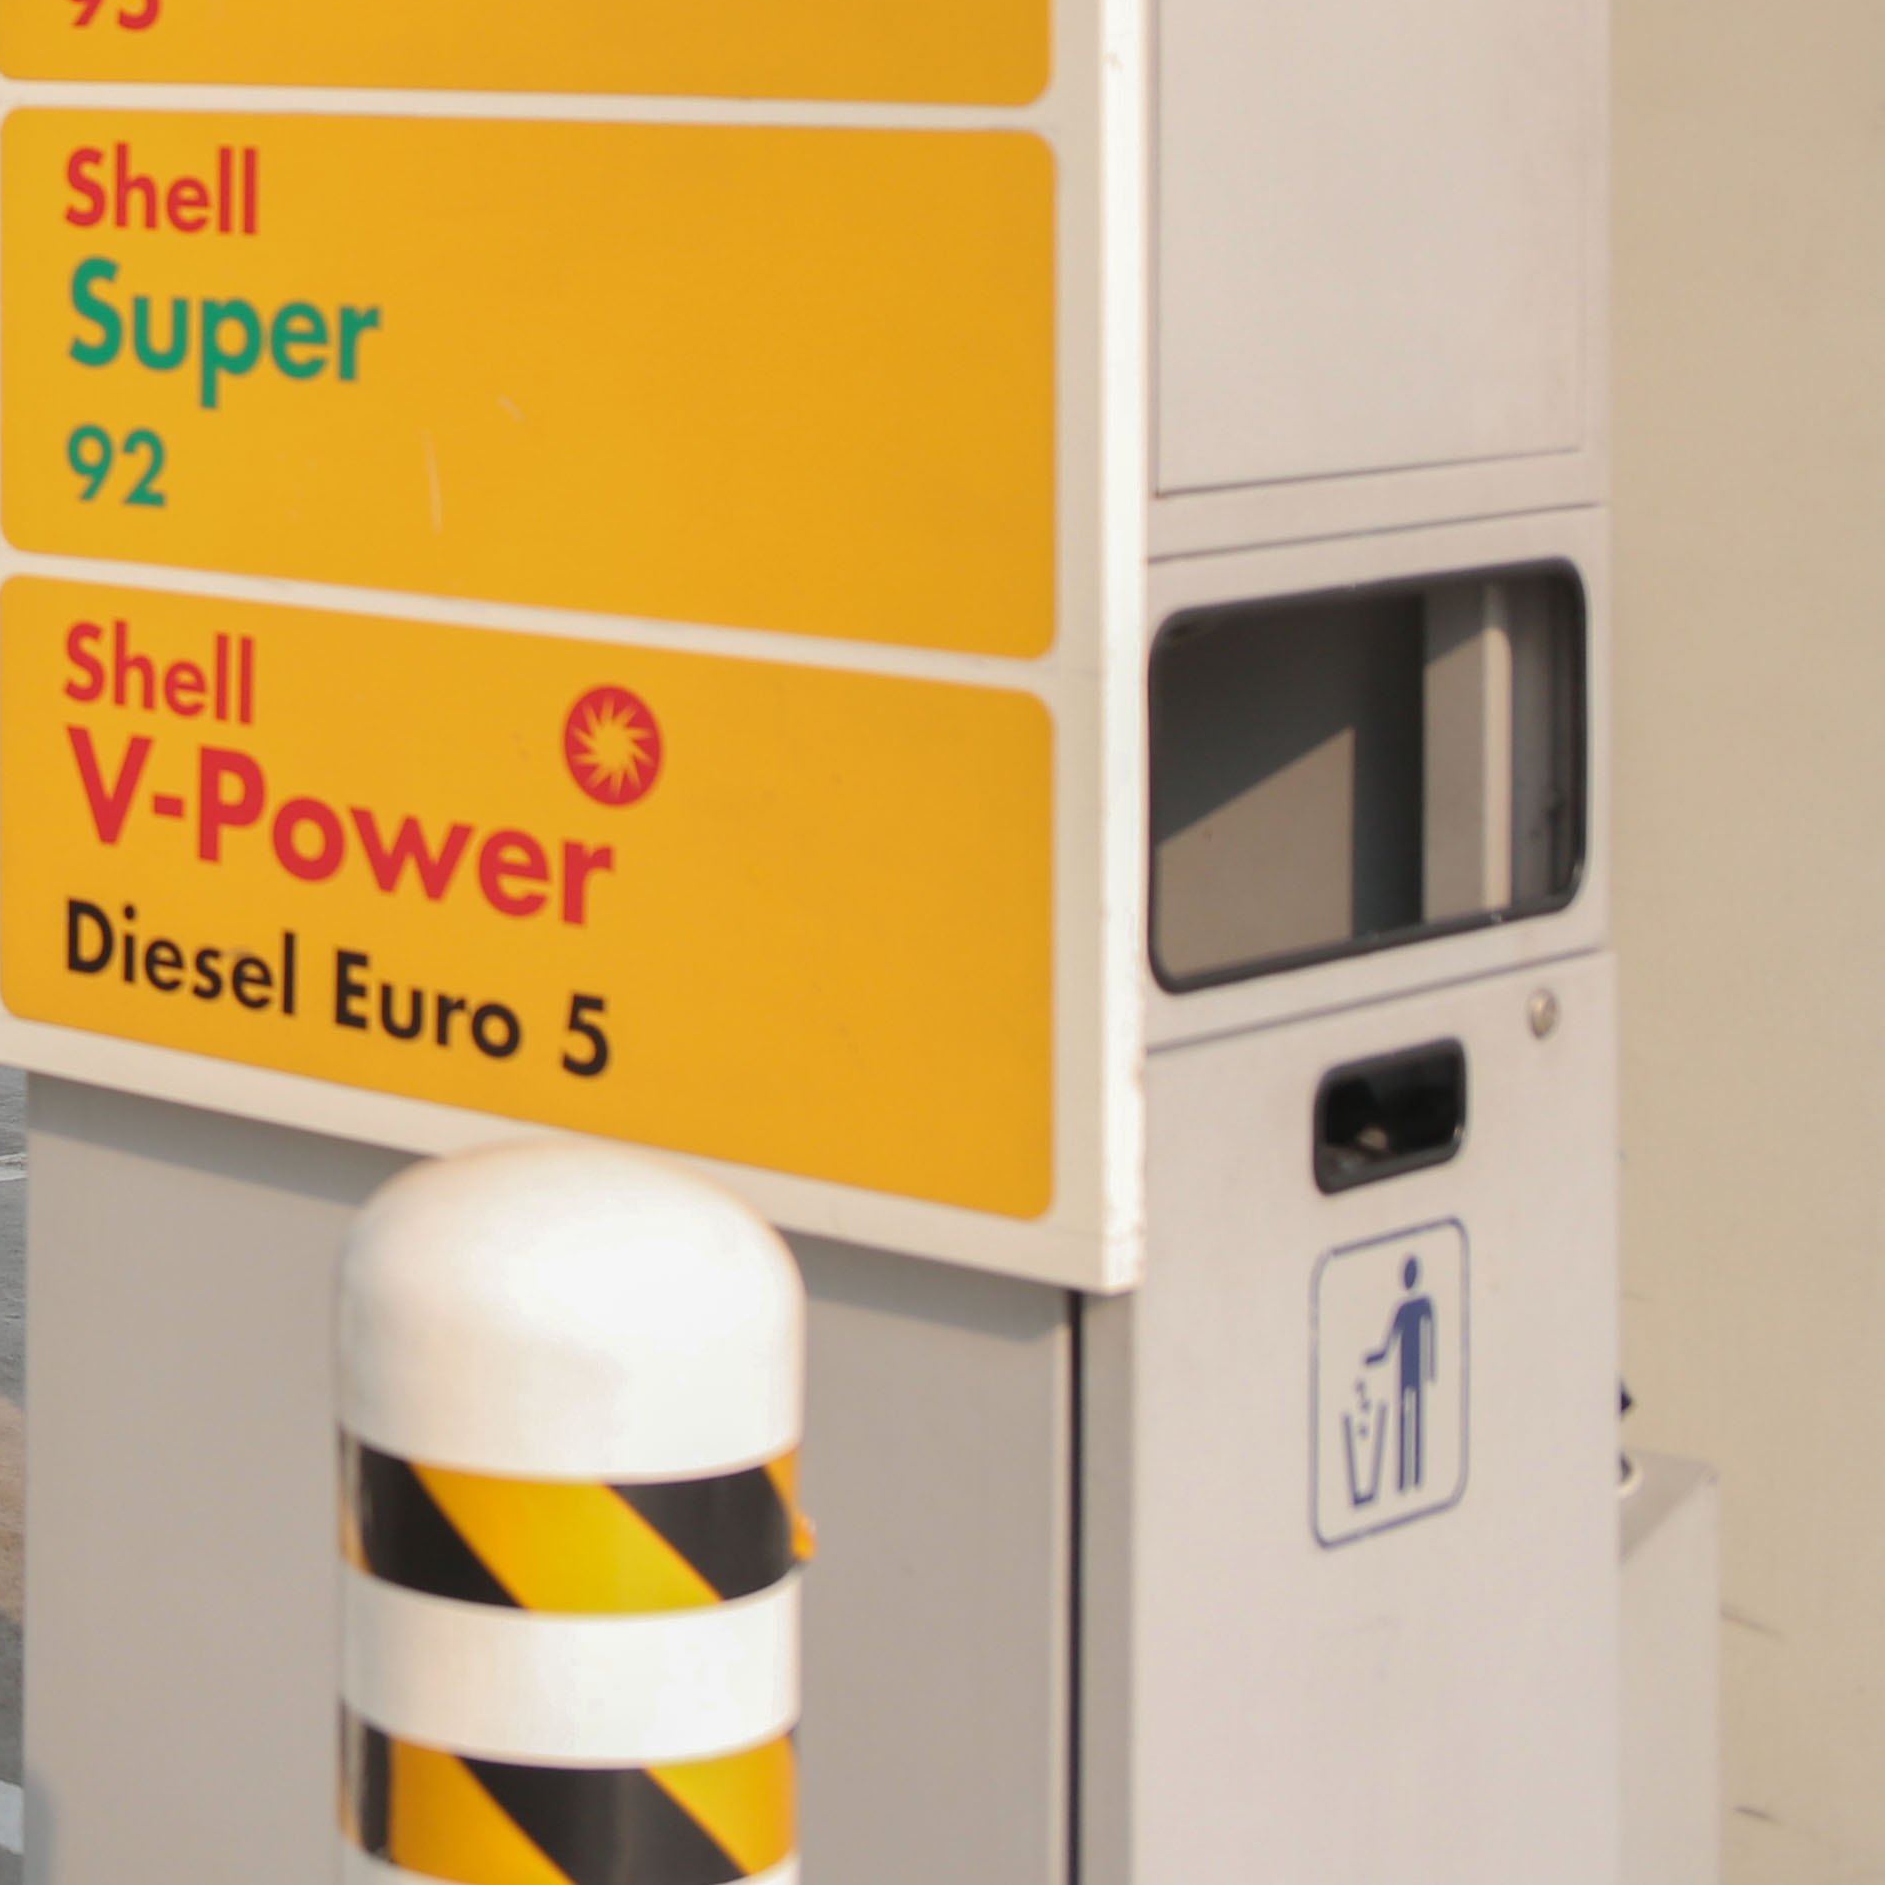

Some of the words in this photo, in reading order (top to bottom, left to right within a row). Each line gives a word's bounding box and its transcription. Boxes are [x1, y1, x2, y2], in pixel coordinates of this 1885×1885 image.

[64, 143, 259, 236] Shell
[69, 255, 381, 409] Super
[67, 424, 167, 507] 92
[64, 620, 254, 724] Shell
[65, 723, 613, 926] V-Power
[66, 896, 298, 1016] Diesel
[335, 949, 521, 1059] Euro
[562, 993, 610, 1077] 5
